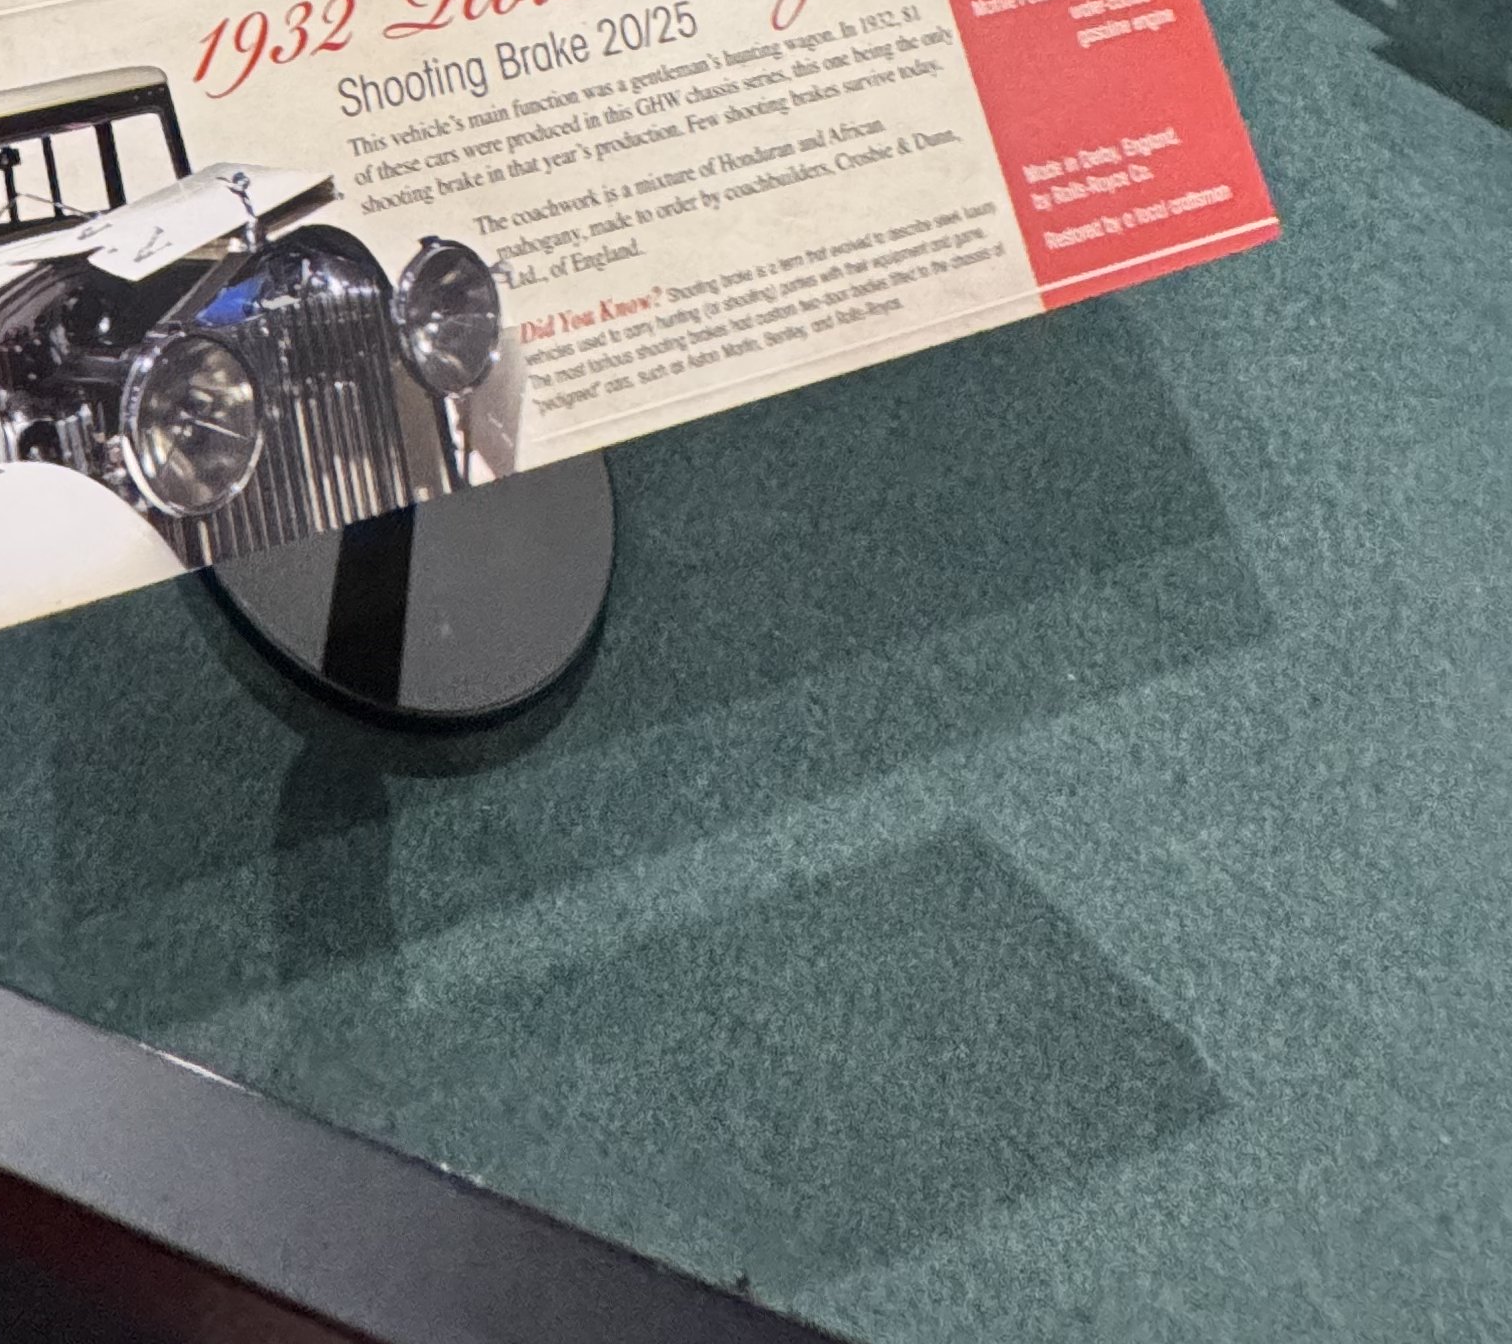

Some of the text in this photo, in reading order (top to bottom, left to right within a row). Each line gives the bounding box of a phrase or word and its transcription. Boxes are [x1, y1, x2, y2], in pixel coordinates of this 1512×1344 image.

[1077, 8, 1175, 48] gasoline engine
[338, 0, 697, 116] Shooting Brake 20/25
[347, 136, 387, 156] This
[391, 115, 464, 144] vehicle's
[468, 107, 510, 128] main
[512, 91, 579, 117] function
[581, 82, 614, 99] was
[617, 79, 628, 92] a
[630, 53, 721, 94] gentleman's
[722, 43, 782, 66] hunting
[783, 30, 836, 51] wagon.
[838, 21, 858, 39] In
[859, 10, 901, 33] 1932,
[354, 164, 373, 186] of
[376, 158, 420, 180] these
[425, 149, 460, 168] cars
[462, 138, 502, 157] were
[506, 115, 581, 154] produced
[583, 115, 602, 130] in
[603, 106, 633, 124] this
[635, 91, 679, 116] GHW
[685, 81, 739, 104] chassis
[791, 60, 820, 78] this
[822, 54, 850, 70] one
[851, 43, 894, 63] being
[895, 35, 919, 52] the
[920, 25, 952, 46] only
[361, 59, 943, 214] shooting brake in that year's production. Few shooting brakes survive today.
[473, 120, 885, 235] The coachwork is a mixture of Honduran and African
[1022, 160, 1063, 183] Made
[1063, 156, 1080, 172] in
[1031, 193, 1051, 210] by
[1051, 171, 1129, 203] Rolls-Royce
[496, 229, 587, 268] mahogany,
[589, 211, 632, 236] made
[634, 209, 653, 224] to
[656, 196, 697, 219] order
[699, 190, 720, 210] by
[724, 163, 834, 200] coachbuilders,
[897, 137, 912, 155] &
[1044, 221, 1104, 248] Restored
[1100, 216, 1122, 233] by
[1133, 200, 1168, 223] local
[549, 255, 568, 278] of
[570, 238, 643, 272] England.
[520, 314, 555, 344] Did
[558, 311, 595, 332] You
[599, 286, 661, 322] Know?
[666, 279, 719, 302] Shooting
[655, 308, 701, 328] hunting
[527, 373, 553, 389] The
[635, 335, 687, 360] shooting
